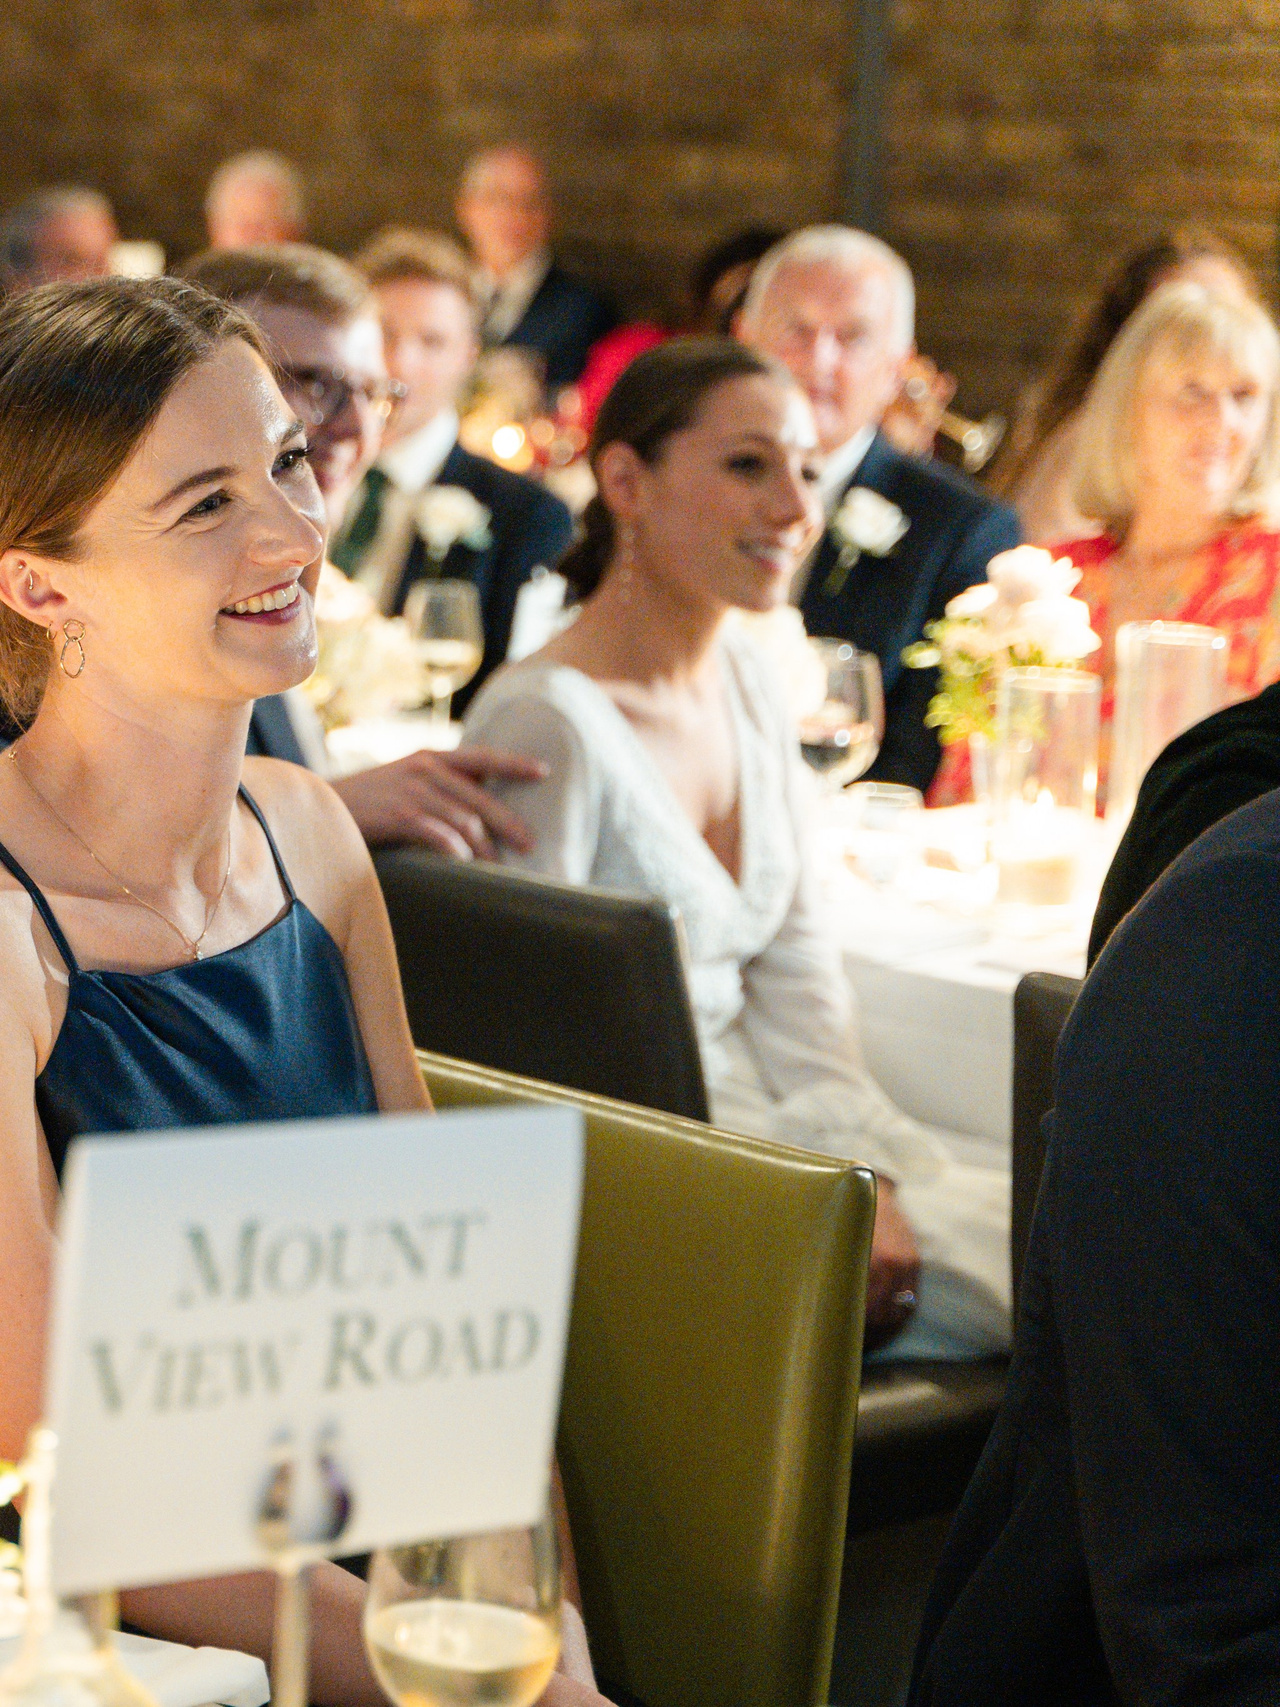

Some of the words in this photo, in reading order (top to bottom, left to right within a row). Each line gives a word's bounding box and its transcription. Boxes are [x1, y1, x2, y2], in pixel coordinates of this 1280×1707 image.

[175, 1208, 488, 1308] MOUNT
[88, 1329, 304, 1415] VIEW
[323, 1304, 542, 1391] ROAD
